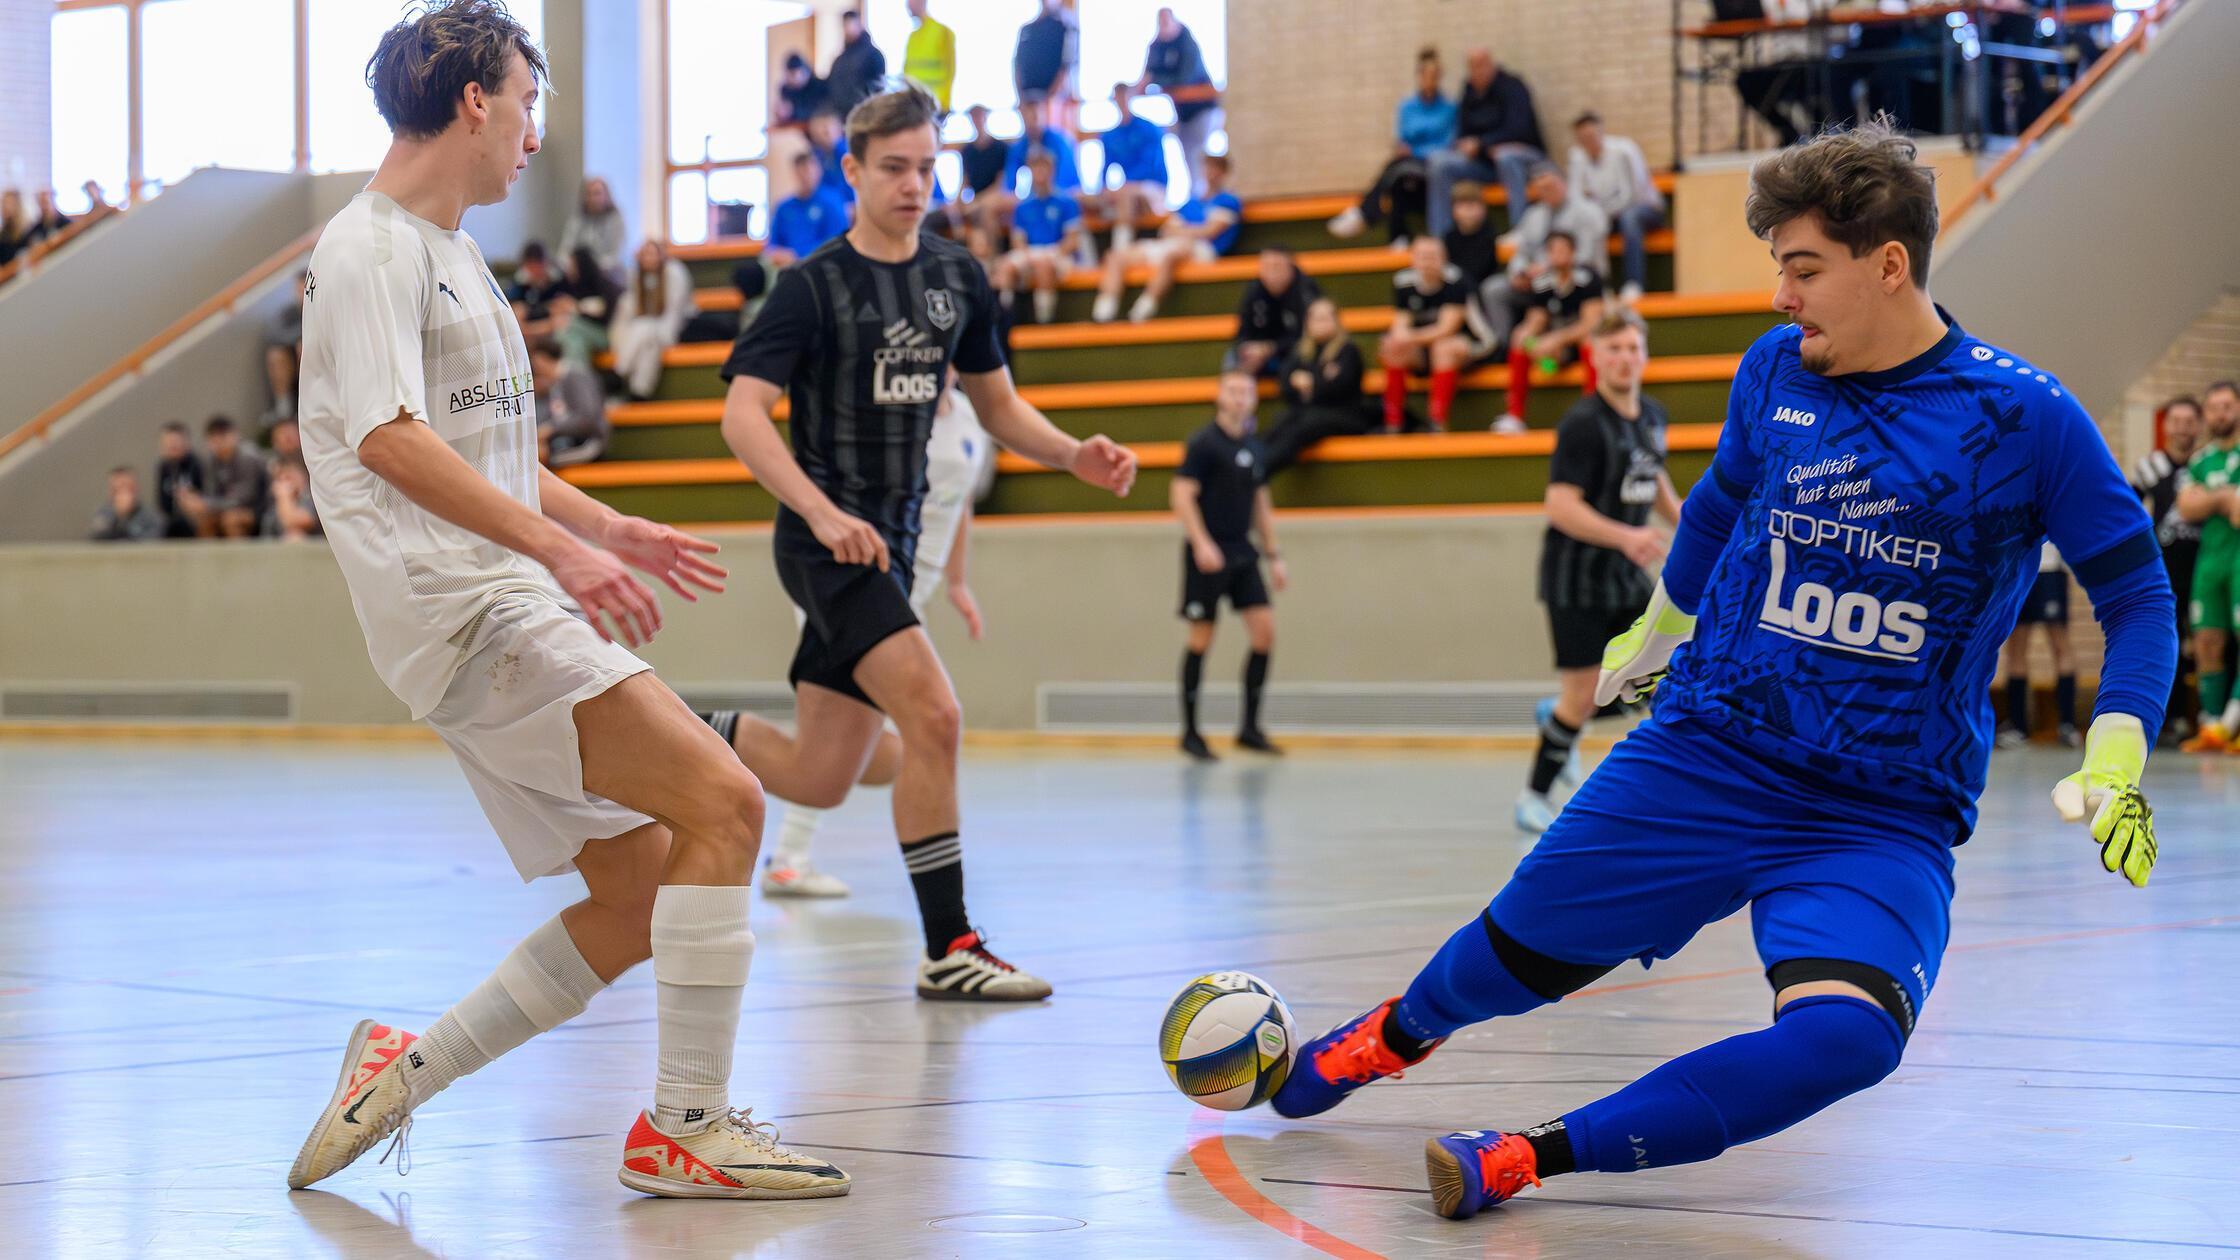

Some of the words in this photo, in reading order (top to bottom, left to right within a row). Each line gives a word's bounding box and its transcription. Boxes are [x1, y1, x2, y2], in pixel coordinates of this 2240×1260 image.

[1772, 406, 1816, 427] JAKO
[1786, 453, 1859, 485] Qualität
[1794, 482, 1826, 505] hat
[1828, 476, 1872, 500] einen
[1838, 496, 1911, 522] Namen...
